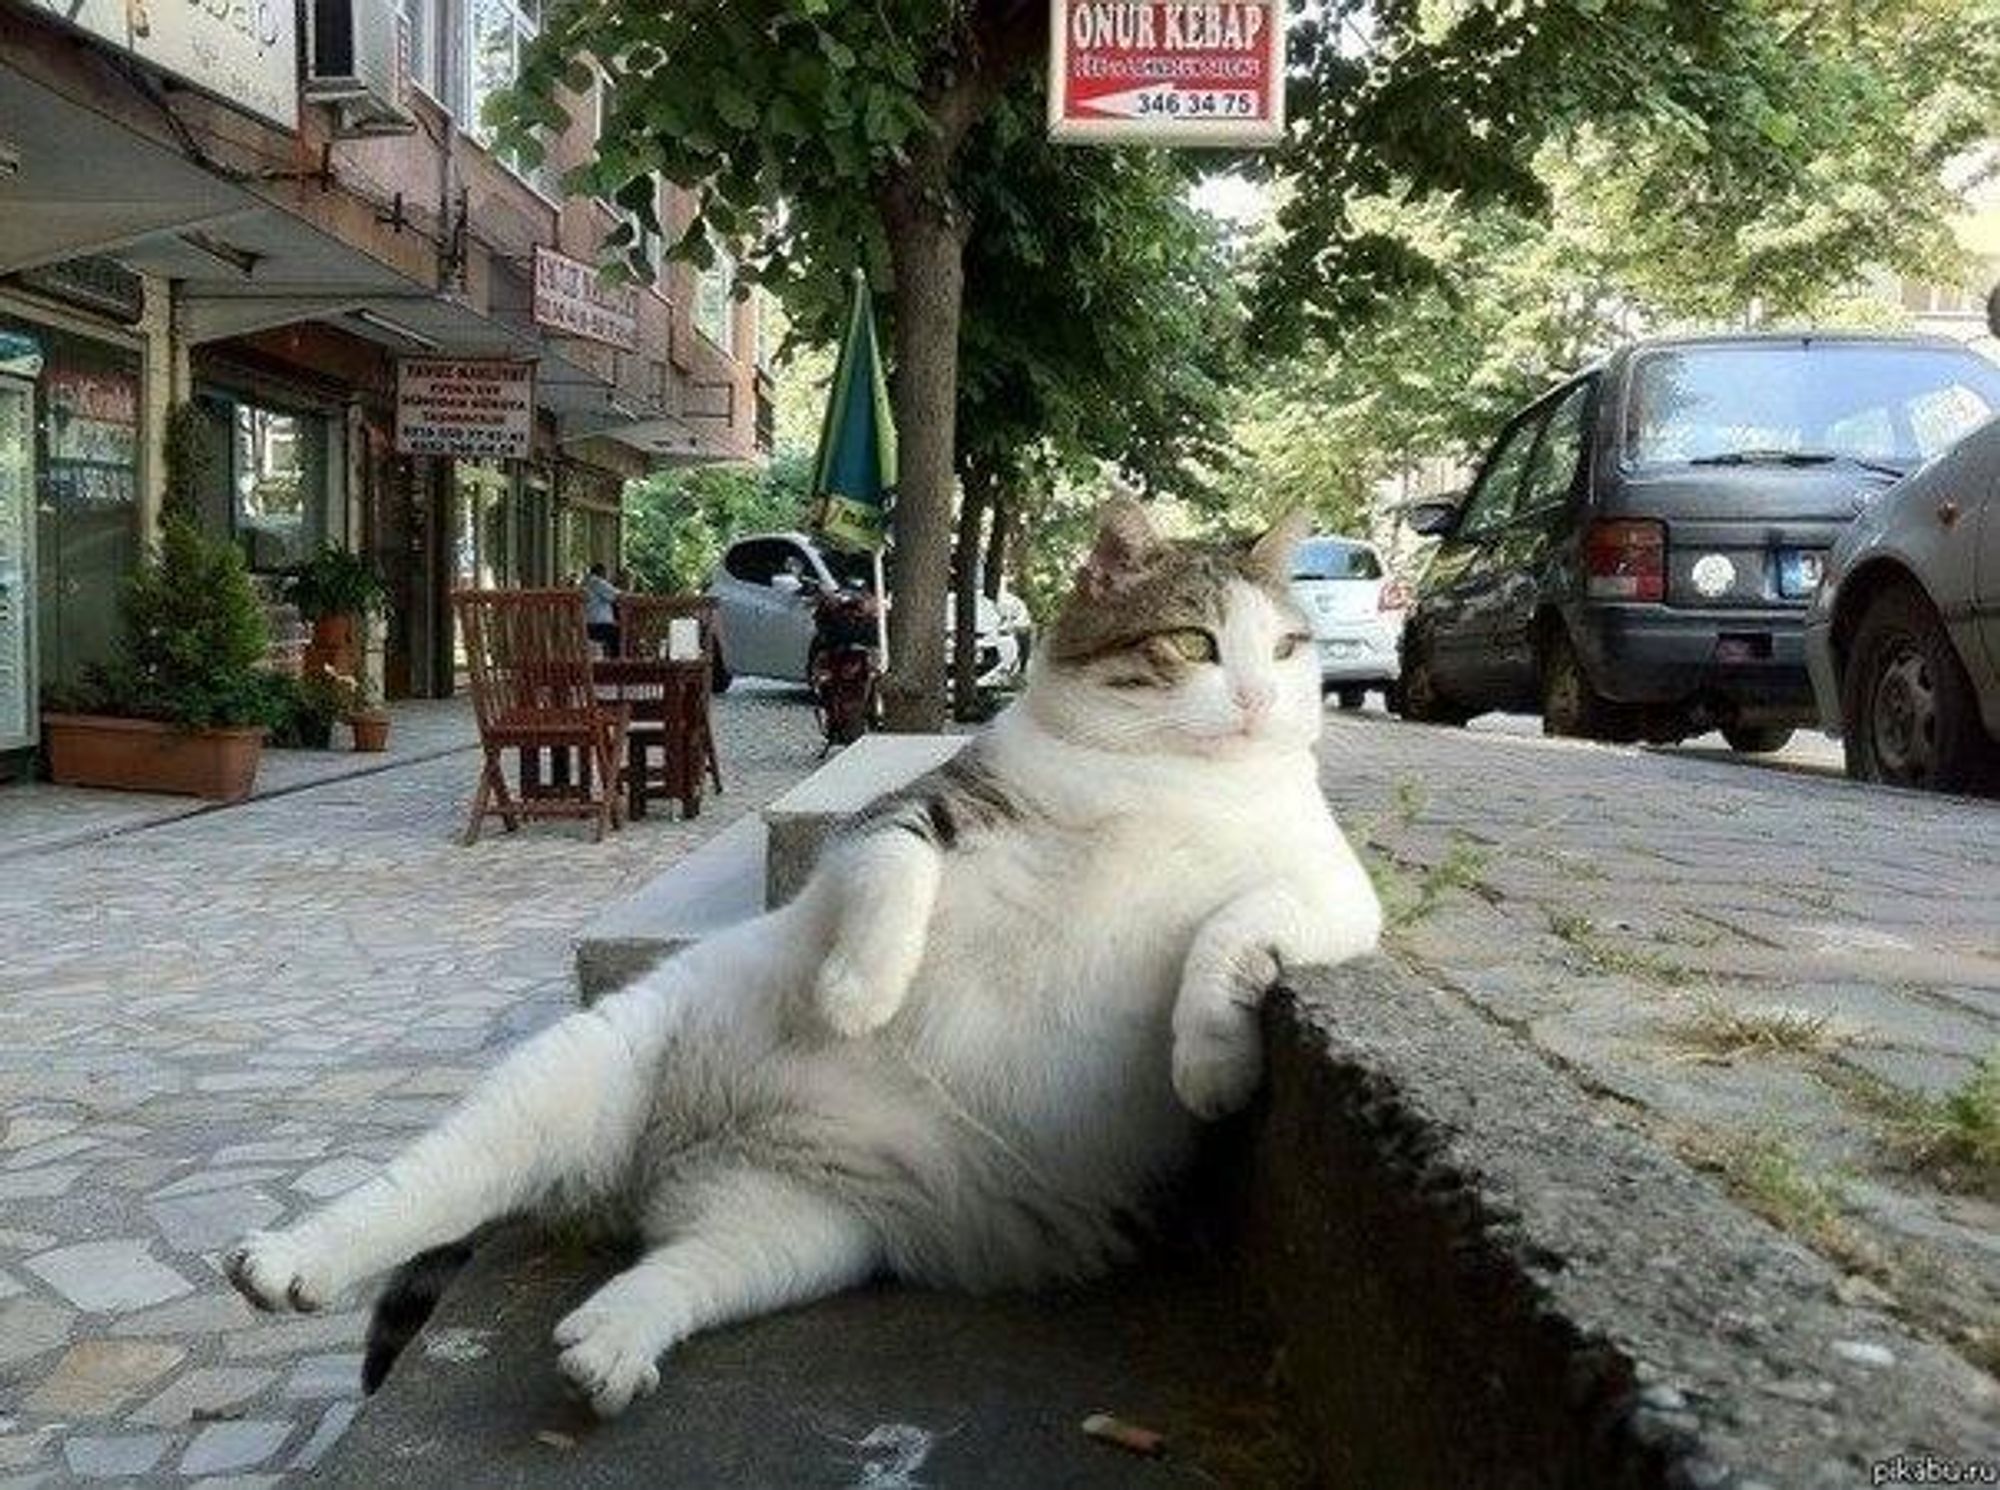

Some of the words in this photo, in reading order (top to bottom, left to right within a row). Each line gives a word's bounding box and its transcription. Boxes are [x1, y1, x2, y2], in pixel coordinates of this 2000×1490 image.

[1073, 3, 1156, 48] ONUR
[1163, 5, 1263, 49] KEBAP
[1138, 93, 1180, 114] 346
[1188, 93, 1217, 114] 34
[1223, 93, 1252, 114] 75
